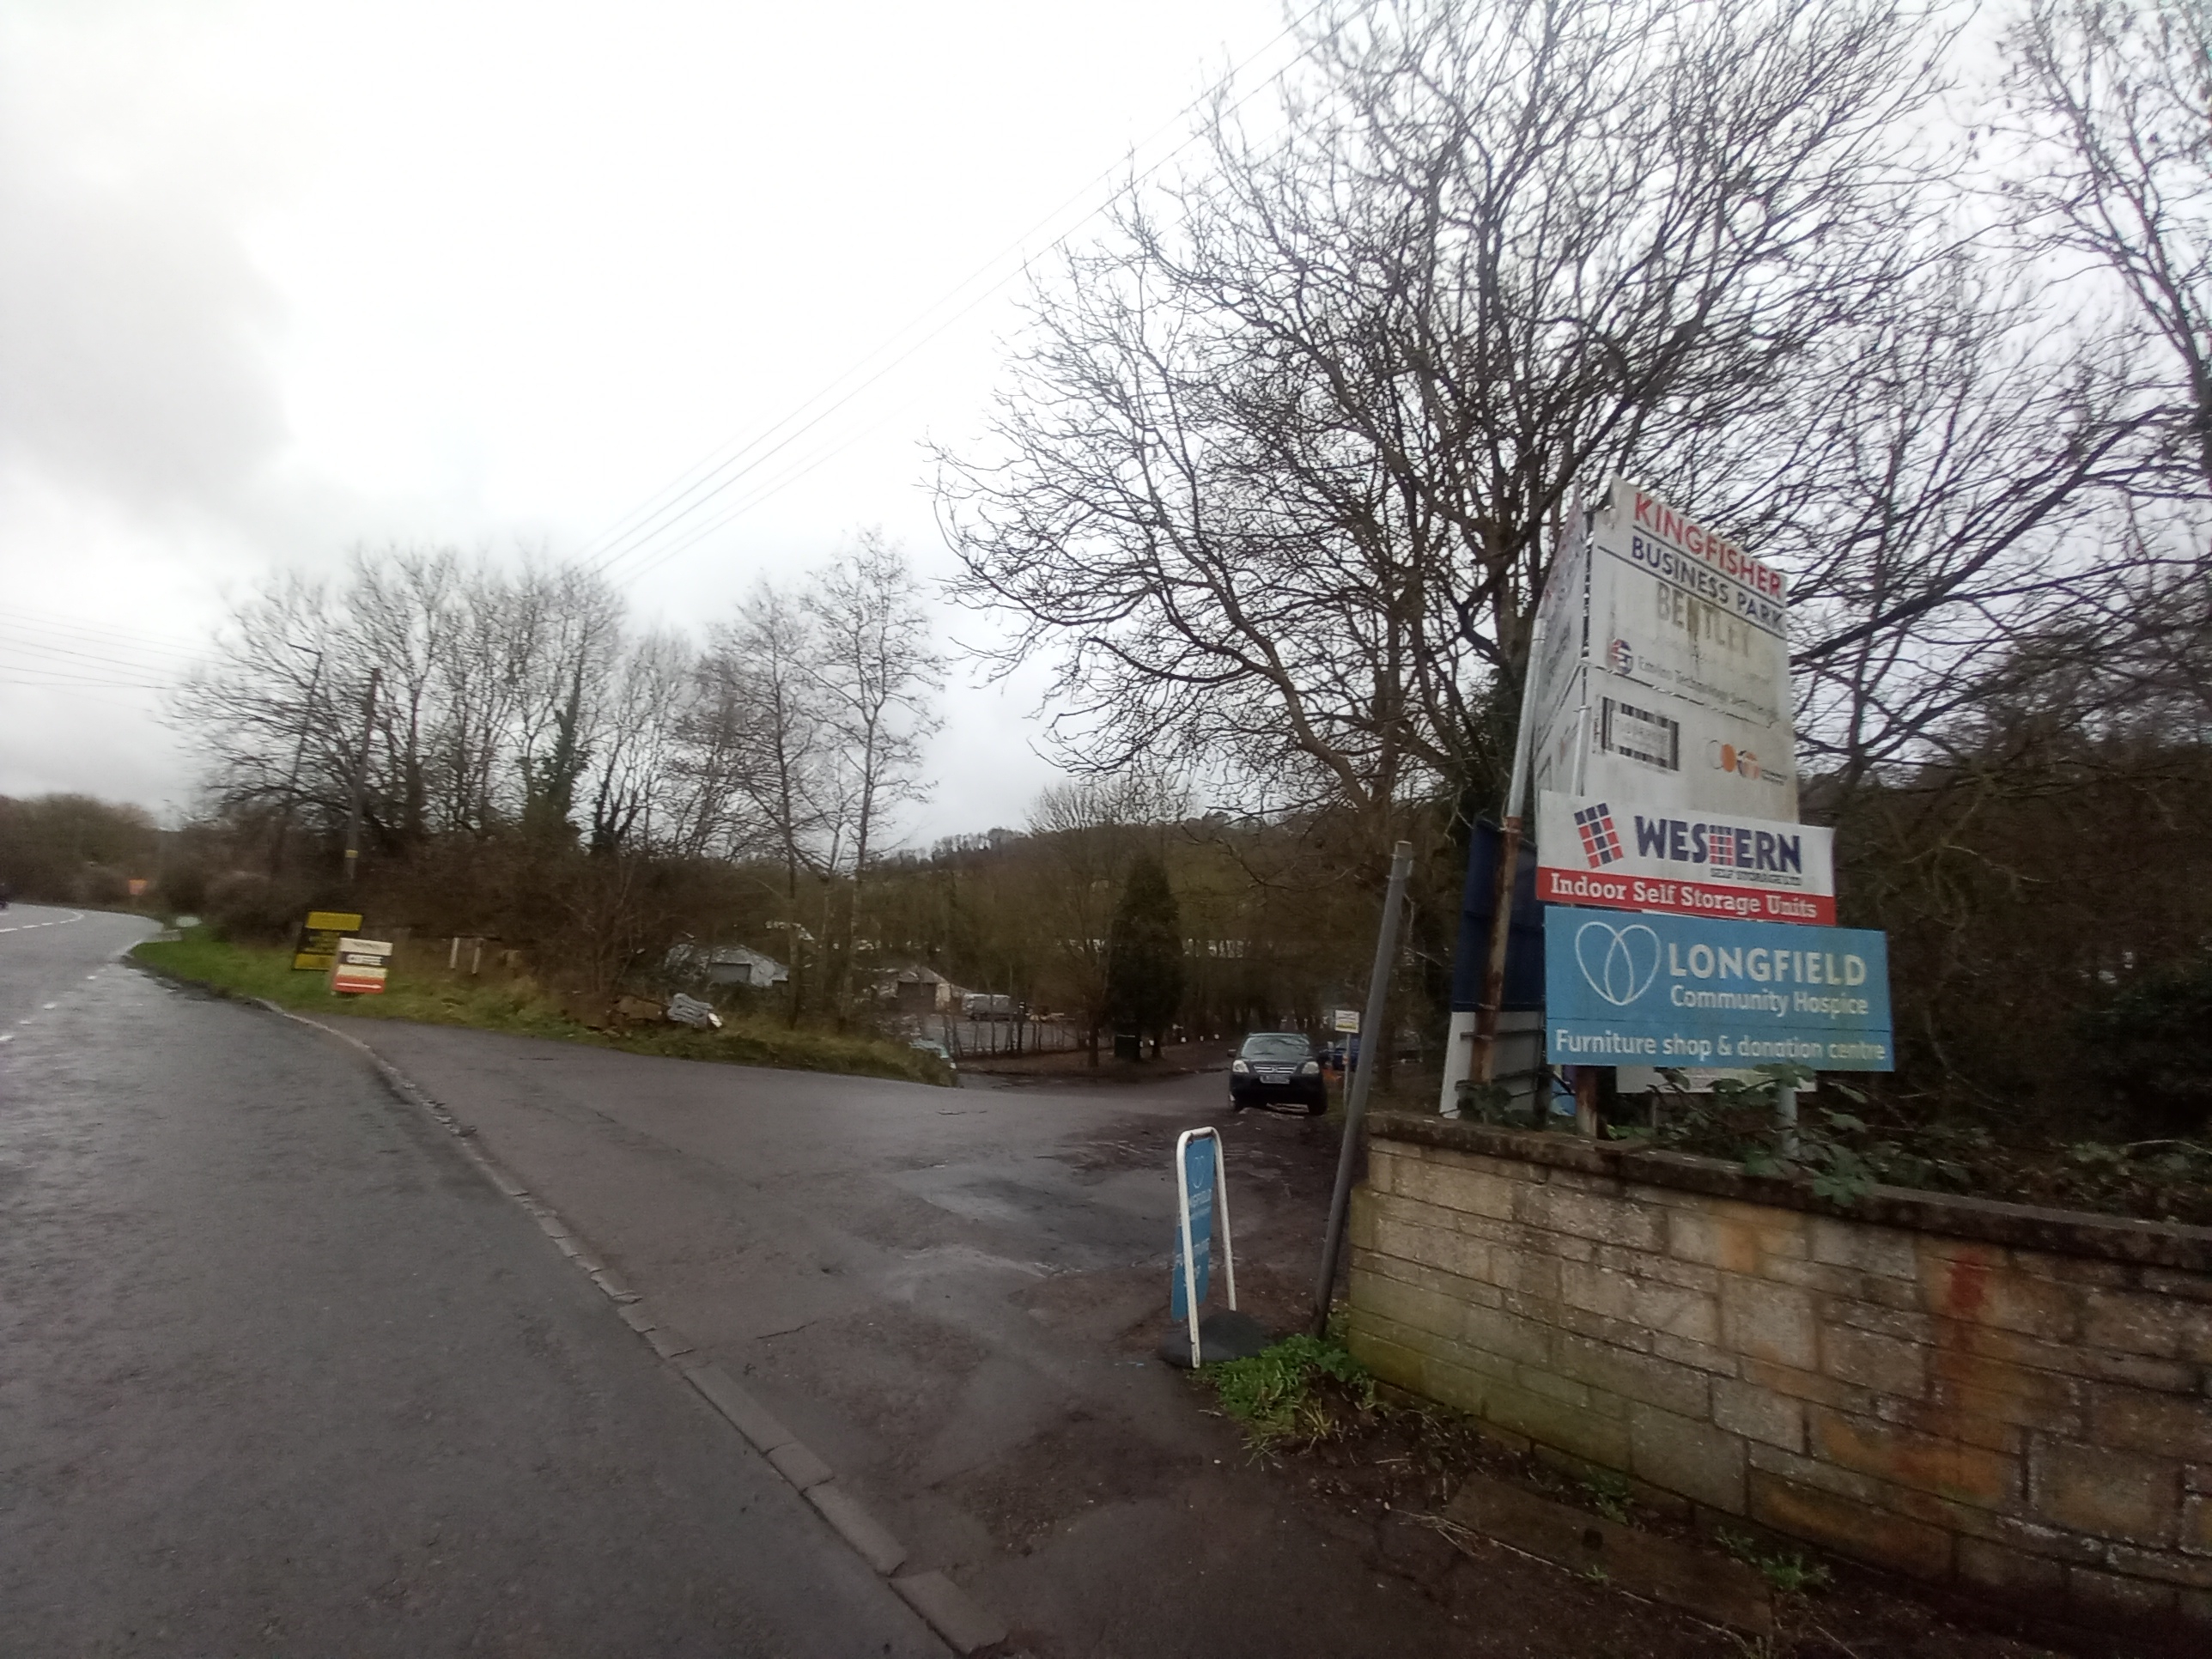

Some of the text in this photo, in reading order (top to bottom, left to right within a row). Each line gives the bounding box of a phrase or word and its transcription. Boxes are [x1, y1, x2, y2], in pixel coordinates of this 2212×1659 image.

[1635, 493, 1783, 599] KINGFISHER
[1632, 536, 1784, 634] BUSINESS PARK
[1634, 815, 1802, 874] WESTERN
[1551, 872, 1817, 918] Indoor Self Storage Units
[1668, 943, 1867, 986] LONGFIELD
[1670, 985, 1869, 1019] Community Hospice
[1556, 1029, 1886, 1061] Furniture shop & donation centre
